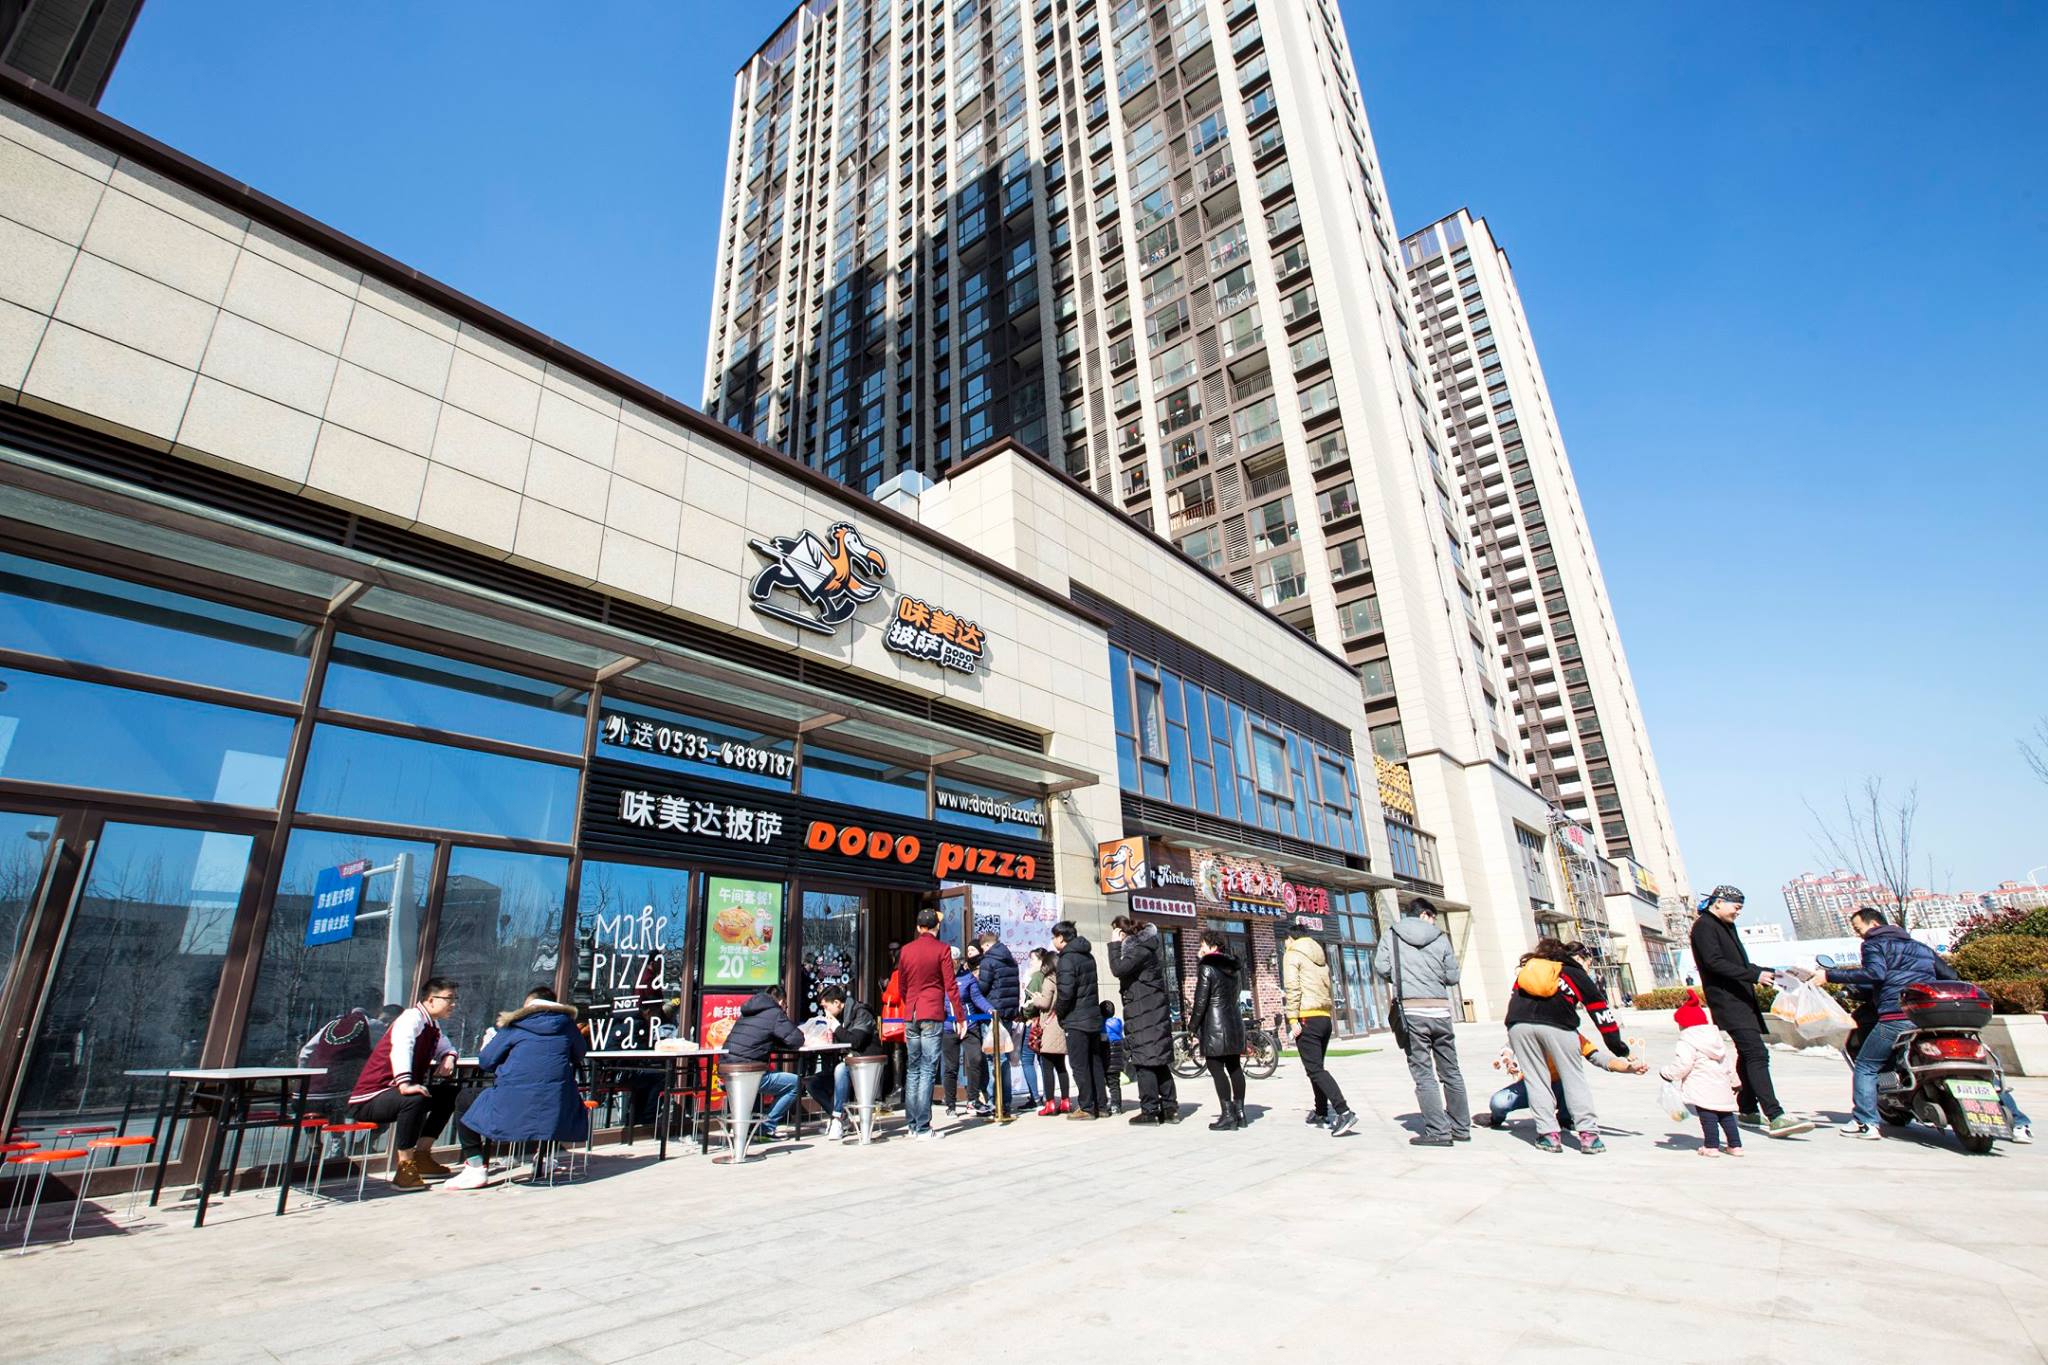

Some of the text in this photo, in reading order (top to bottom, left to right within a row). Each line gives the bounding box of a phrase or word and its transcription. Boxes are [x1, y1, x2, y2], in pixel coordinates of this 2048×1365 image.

[890, 621, 941, 653] 披萨
[899, 597, 984, 652] 味美达
[943, 654, 974, 672] pizza
[945, 646, 972, 662] DODO
[605, 715, 795, 777] 外送 0535-6889187
[620, 791, 783, 845] 味美达披萨
[936, 790, 1046, 827] www.dodopizza.cn
[806, 821, 921, 864] DODO
[1157, 864, 1195, 888] Kitchen
[716, 955, 745, 978] 20
[614, 999, 639, 1009] NOT
